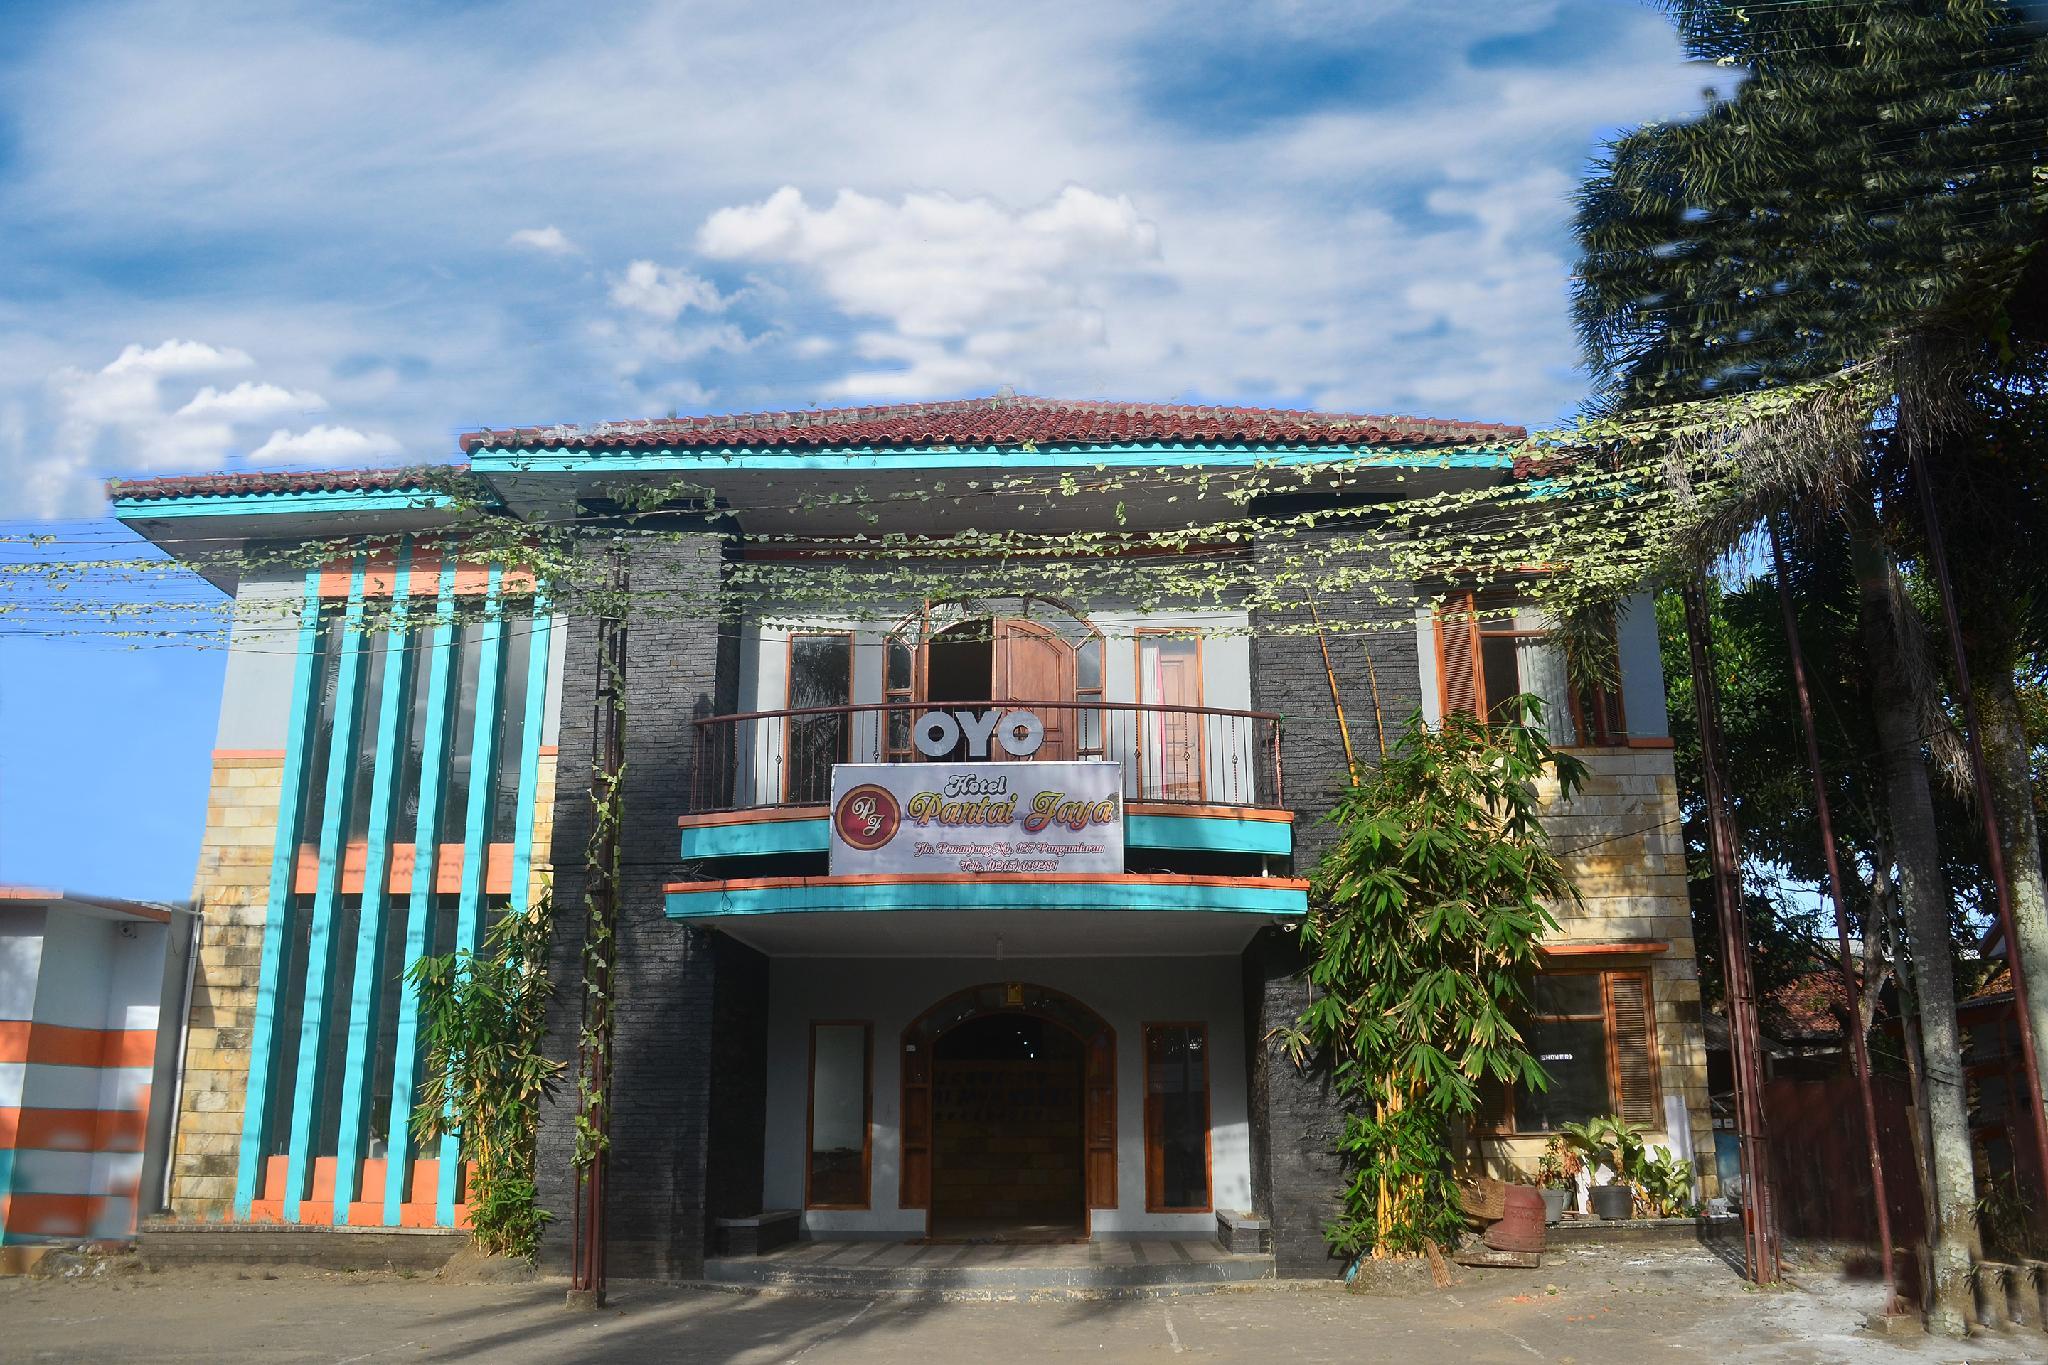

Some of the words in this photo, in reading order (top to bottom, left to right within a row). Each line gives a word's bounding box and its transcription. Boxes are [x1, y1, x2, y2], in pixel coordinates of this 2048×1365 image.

[914, 711, 1045, 757] OYO
[944, 774, 1007, 798] Hotel
[908, 791, 1018, 827] Pantai
[1021, 790, 1116, 834] Jaya
[1036, 841, 1105, 857] Pangandaran
